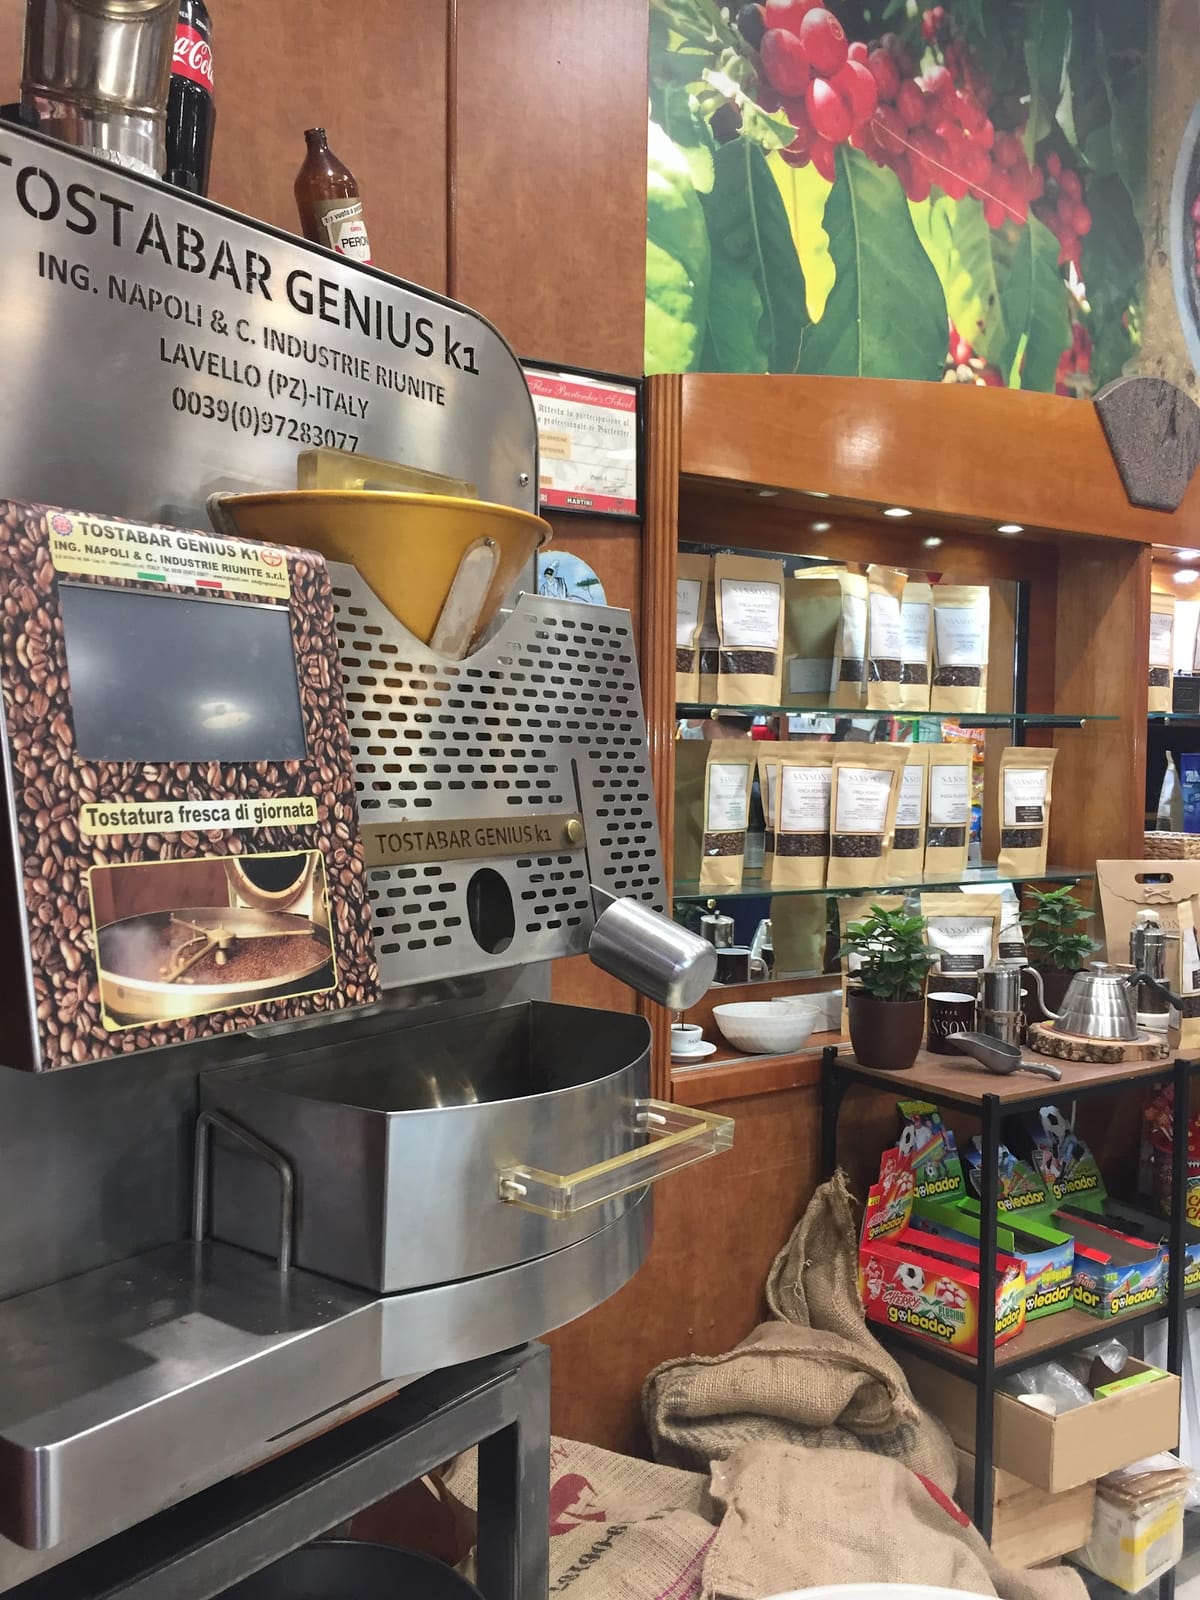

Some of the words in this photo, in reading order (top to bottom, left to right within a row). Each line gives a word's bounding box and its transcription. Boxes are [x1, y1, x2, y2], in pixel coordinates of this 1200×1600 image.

[341, 236, 368, 248] PERO
[39, 251, 98, 294] ING.
[108, 275, 202, 327] NAPOLI
[210, 309, 229, 336] &
[236, 319, 256, 345] C.
[263, 327, 370, 382] INDUSTRIE
[376, 365, 445, 406] RIUNITE
[286, 269, 434, 358] GENIUS
[444, 325, 479, 375] k1
[160, 338, 261, 388] LAVELLO
[269, 369, 369, 419] (PZ)-ITALY
[172, 387, 359, 452] 0039(0)97283077
[567, 496, 592, 506] MARTINI
[78, 521, 172, 548] TOSTABAR
[176, 537, 236, 558] GENIUS
[241, 547, 259, 561] K1
[54, 540, 81, 552] ING.
[85, 544, 129, 559] NAPOLI
[133, 551, 142, 560] &
[145, 553, 157, 563] C.
[160, 555, 218, 571] INDUSTRIE
[222, 563, 263, 577] RIUNITE
[265, 572, 286, 581] s.r.l.
[86, 807, 174, 827] Tostatura
[178, 805, 231, 823] fresca
[235, 803, 249, 820] di
[254, 802, 314, 824] giornata
[375, 829, 472, 854] TOSTABAR
[475, 825, 533, 846] GENIUS
[535, 824, 552, 842] k1
[1053, 1177, 1097, 1199] goleador
[882, 1290, 921, 1309] CHERRY
[1025, 1286, 1071, 1311] oleador
[1111, 1286, 1158, 1313] goleador
[888, 1306, 954, 1338] goleador
